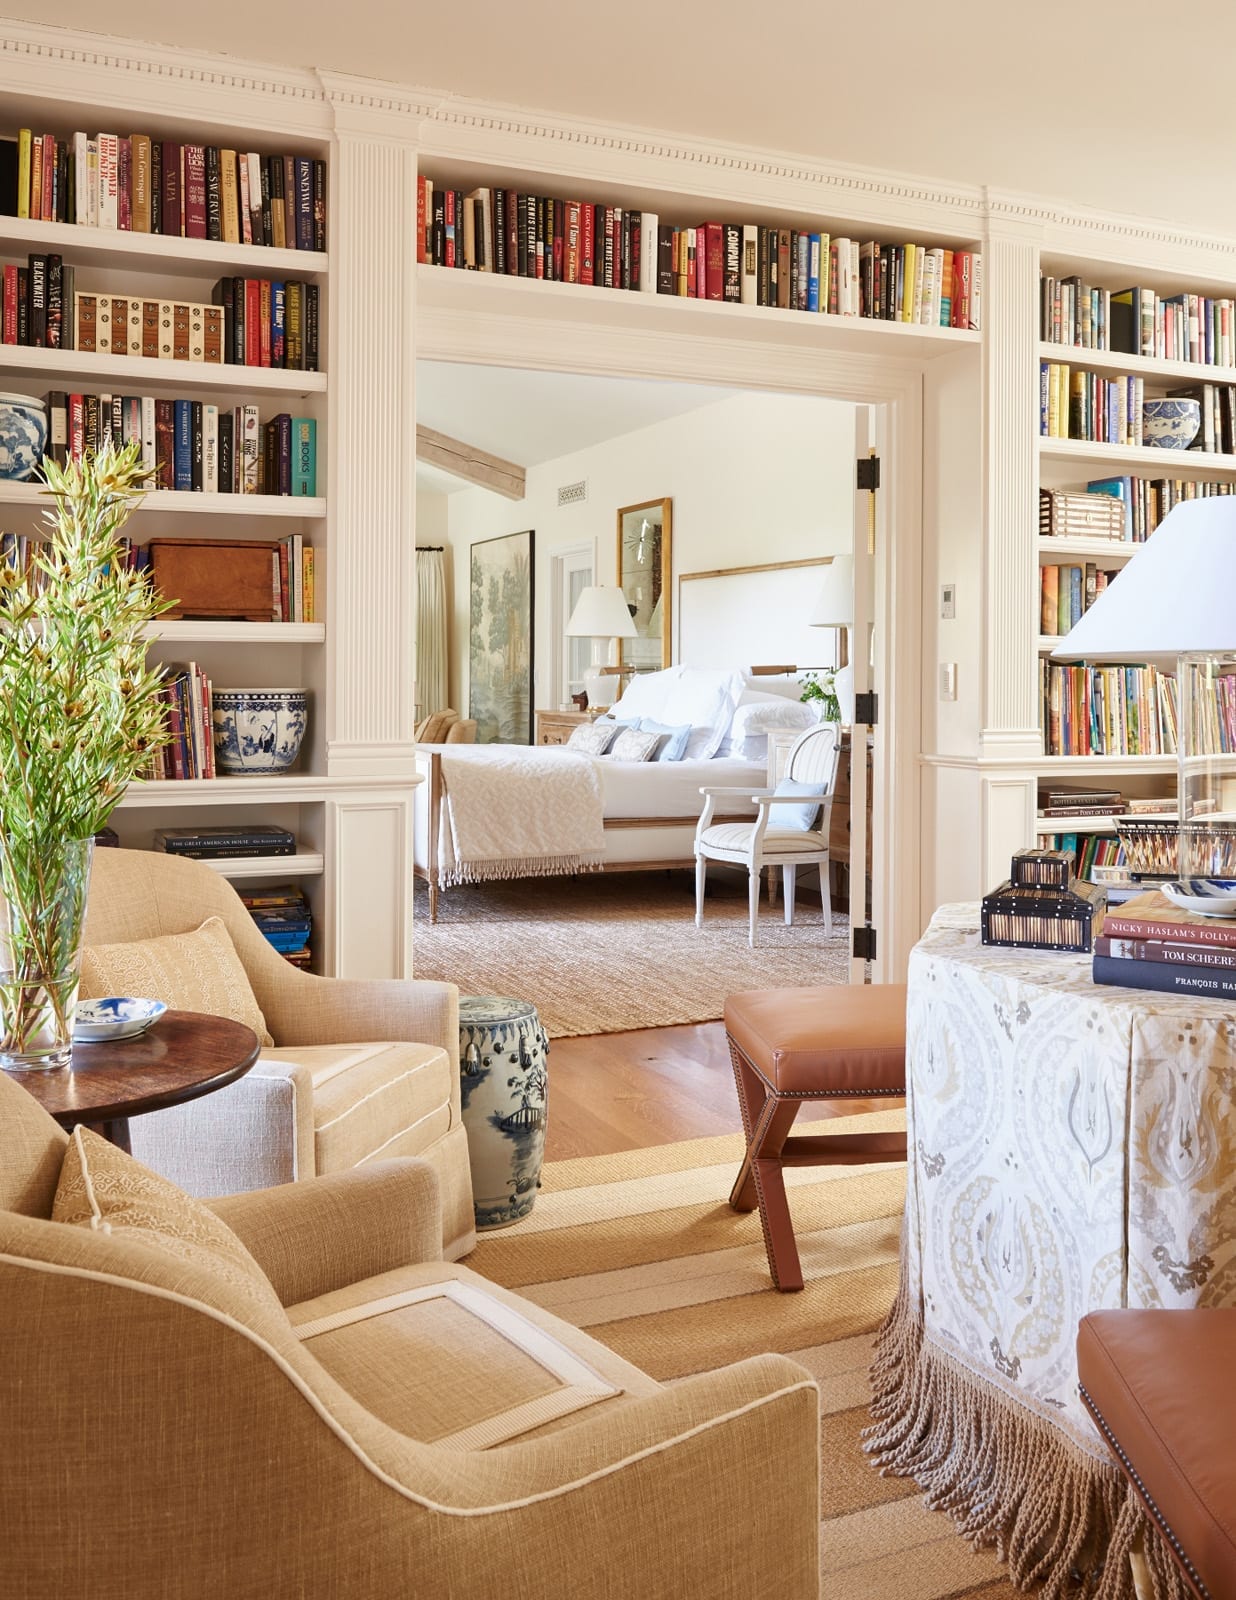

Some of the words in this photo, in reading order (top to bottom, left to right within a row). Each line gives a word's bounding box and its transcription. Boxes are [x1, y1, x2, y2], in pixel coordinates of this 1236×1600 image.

[100, 137, 108, 179] BROKER
[108, 162, 117, 197] POWER
[136, 161, 147, 204] Greenspan
[166, 170, 176, 202] NAPA
[224, 169, 234, 188] Help
[300, 161, 310, 213] DISNEYWAR
[209, 175, 219, 223] SWERVE
[528, 226, 536, 254] LEHANE
[727, 230, 739, 272] COMPANY
[33, 261, 44, 309] BLACKWATER
[605, 262, 613, 286] LEHANE
[288, 285, 299, 307] JAMES
[291, 309, 300, 334] ELLROY
[74, 403, 82, 423] THIS
[87, 398, 97, 412] Jack
[113, 398, 122, 427] train
[88, 413, 97, 433] Welch
[74, 430, 82, 454] TOWN
[302, 441, 310, 473] BOOKS
[1111, 922, 1142, 933] NICKY
[1146, 926, 1196, 938] HASLAM'S
[1200, 931, 1230, 941] FOLLY
[1162, 950, 1185, 961] TOM
[1175, 977, 1218, 988] FRANÇOIS
